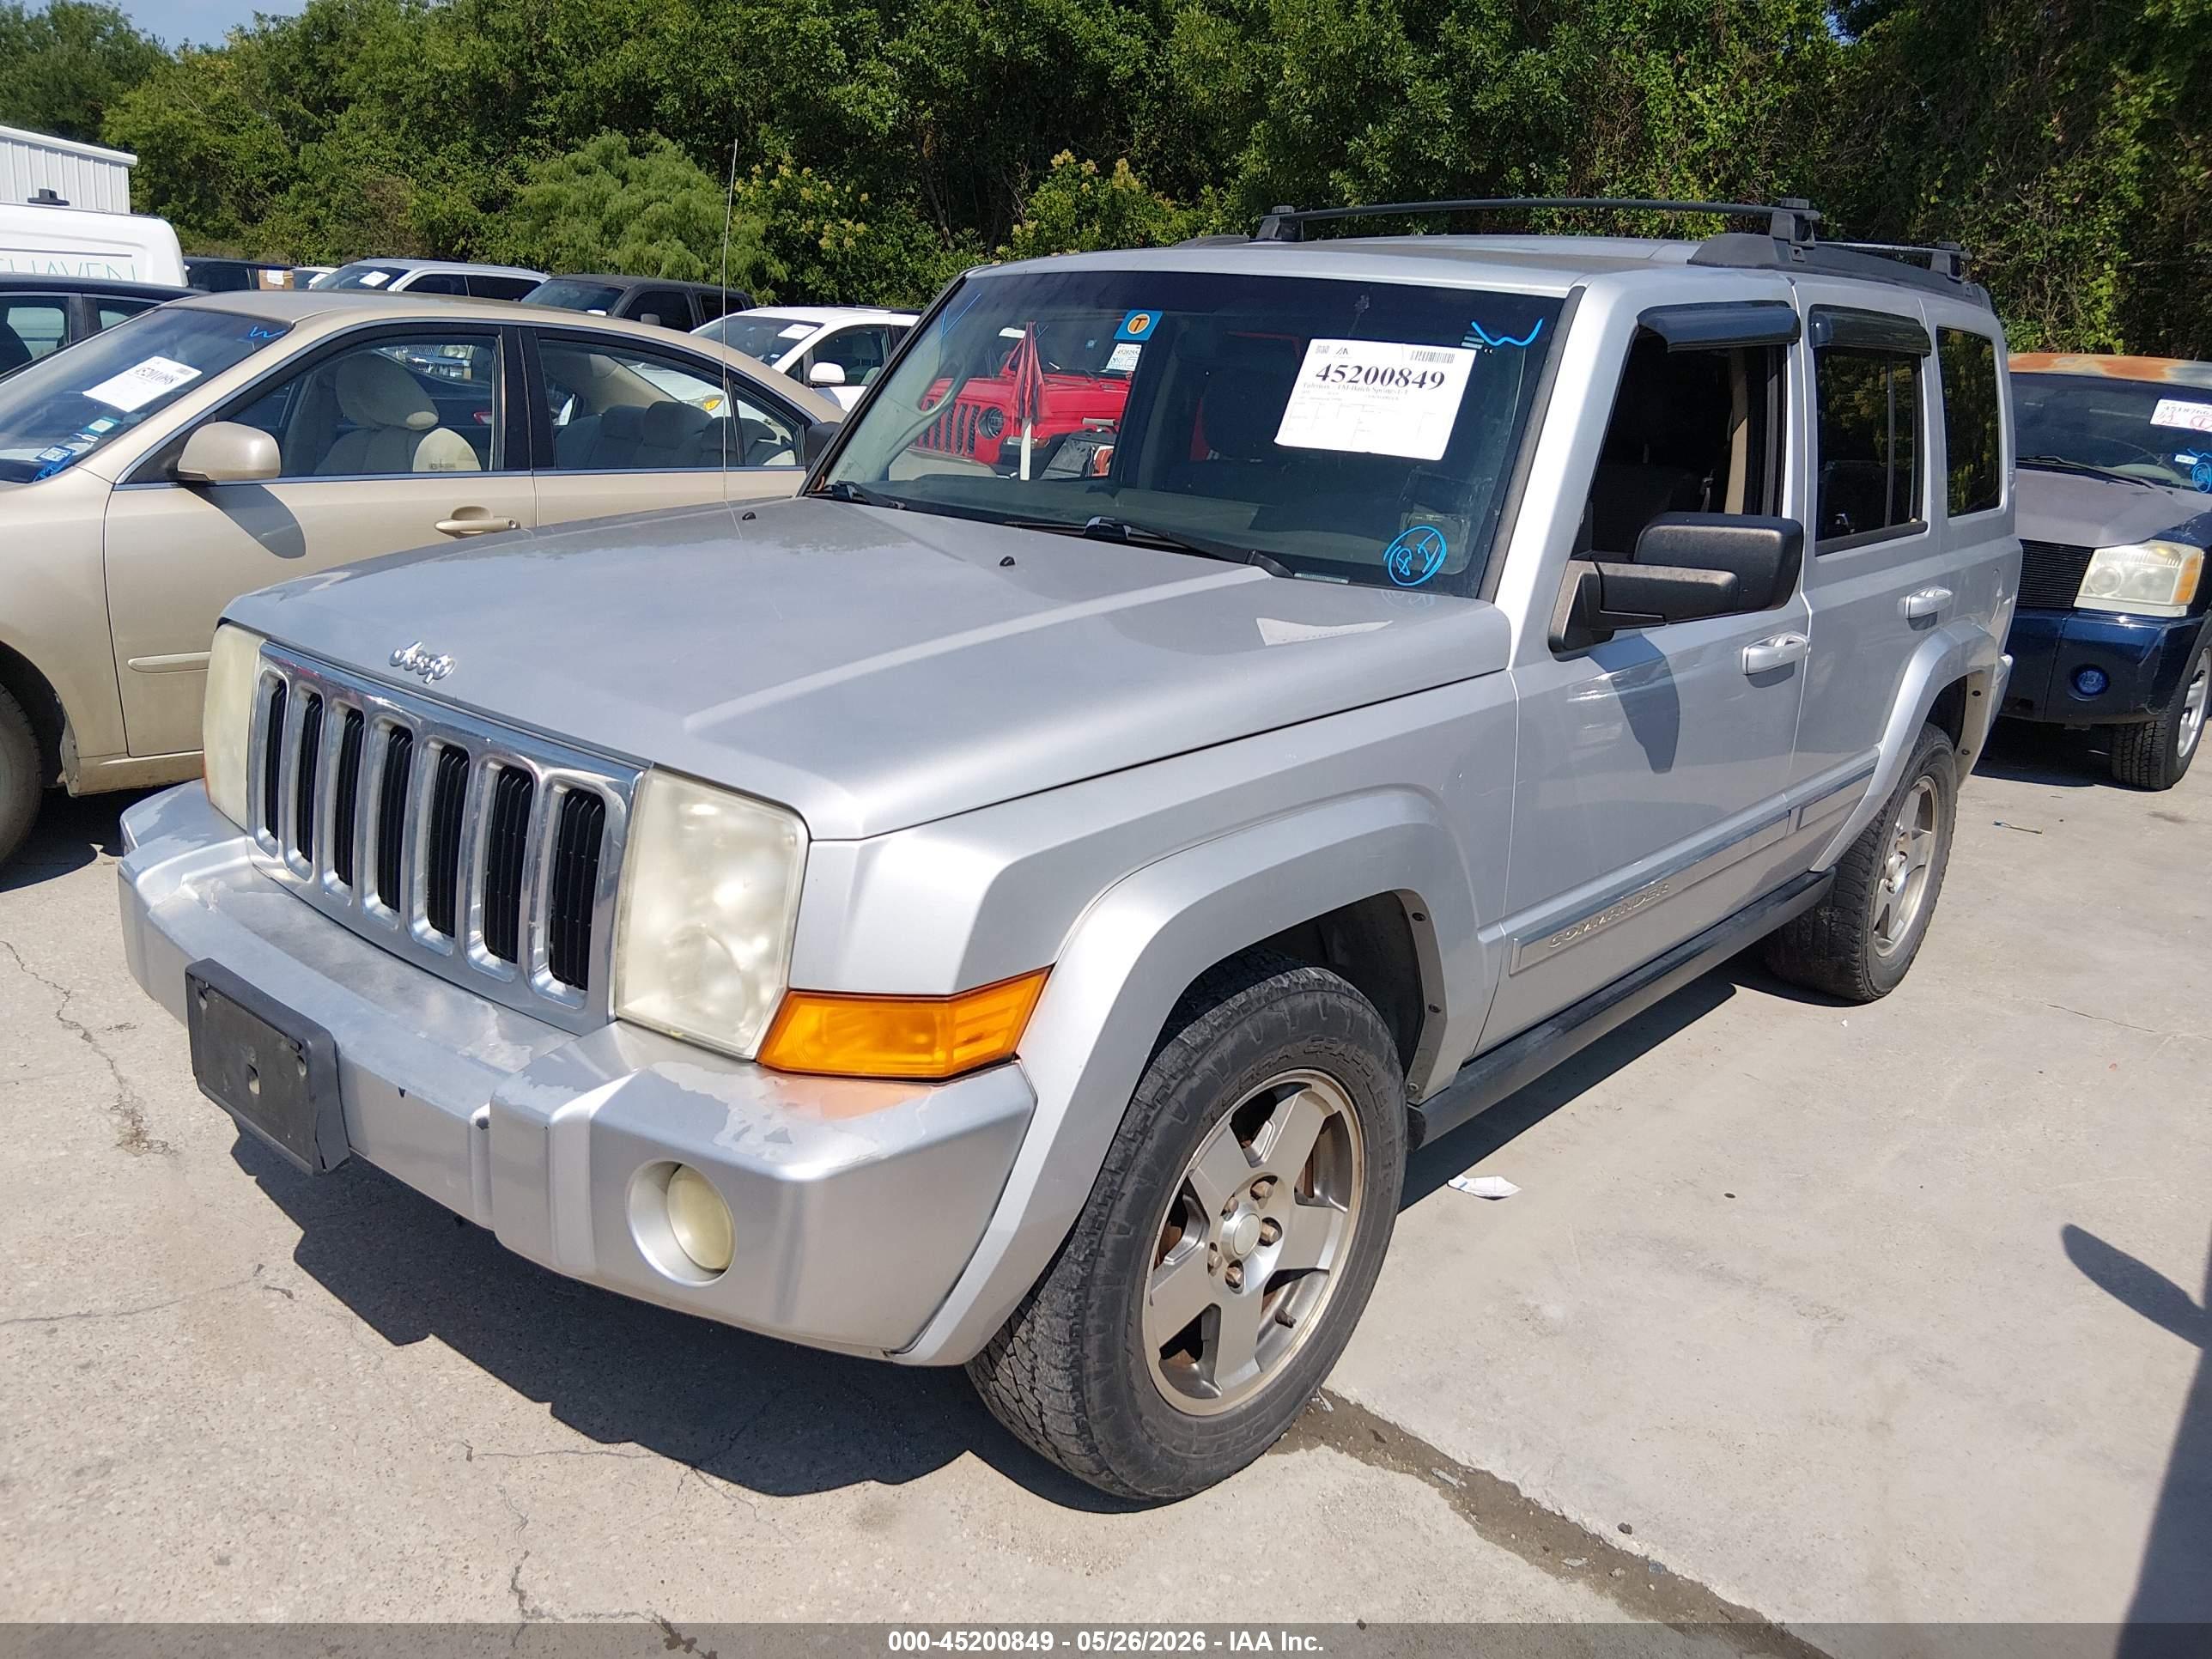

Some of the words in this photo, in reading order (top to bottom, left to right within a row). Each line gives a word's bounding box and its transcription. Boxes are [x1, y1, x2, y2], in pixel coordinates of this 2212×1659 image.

[1133, 317, 1148, 332] T
[1316, 363, 1445, 391] 45200849
[389, 641, 455, 684] Jeep
[1548, 882, 1670, 949] COMMANDER
